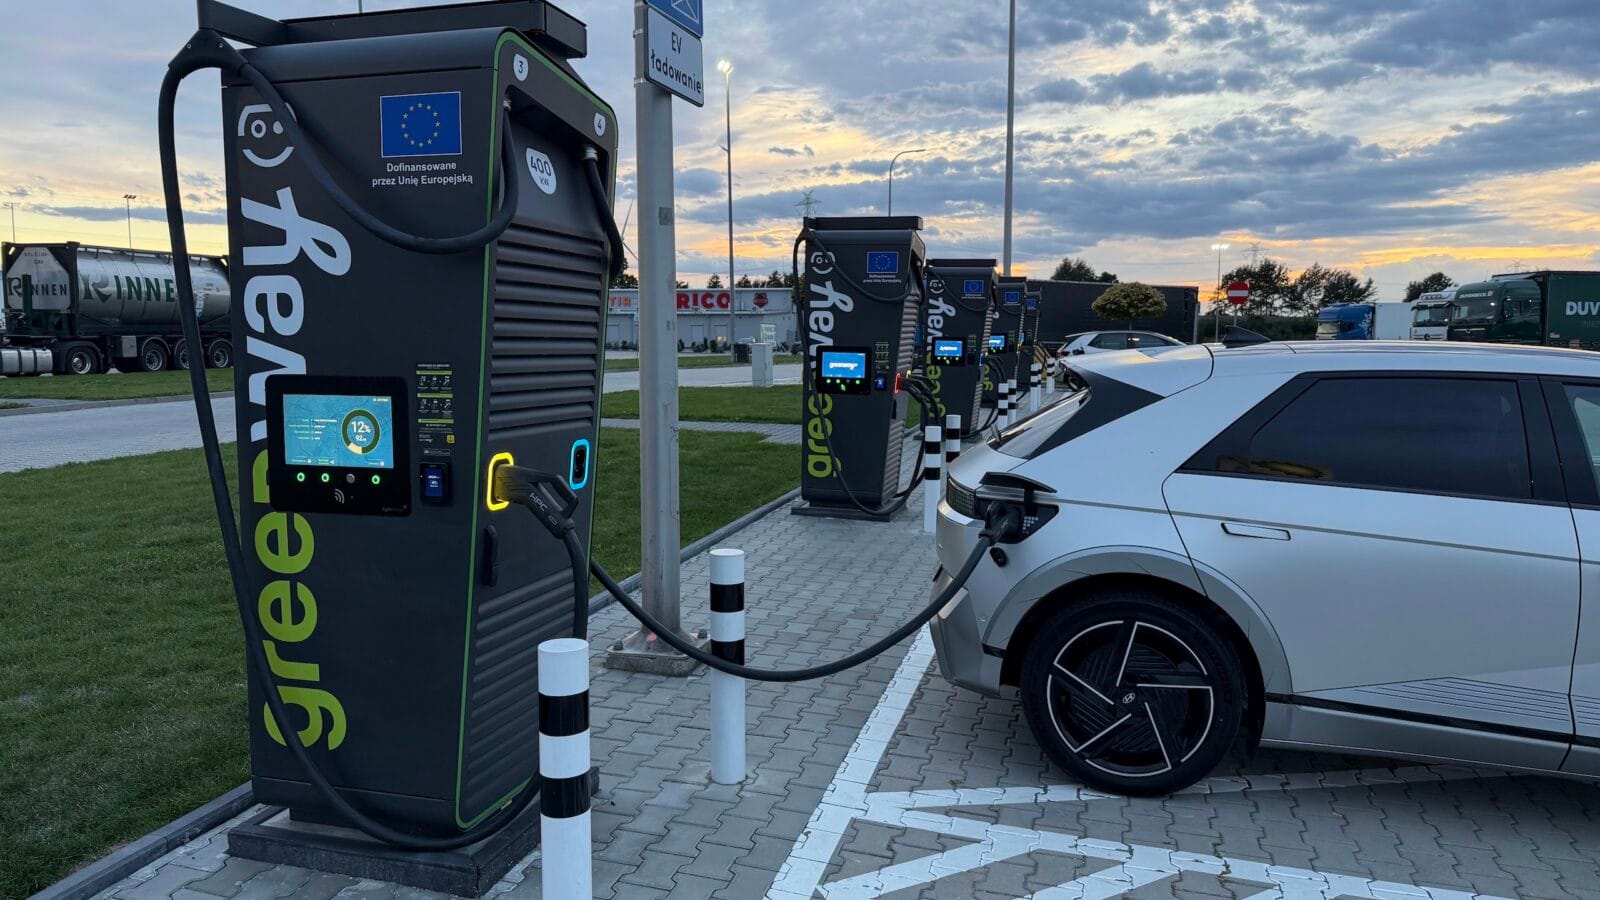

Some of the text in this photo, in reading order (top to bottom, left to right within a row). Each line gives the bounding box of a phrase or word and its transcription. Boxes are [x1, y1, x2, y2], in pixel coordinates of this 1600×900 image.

[671, 31, 683, 55] EV
[518, 60, 524, 74] 3
[650, 48, 703, 94] ładowanie
[386, 162, 457, 172] Dofinansowane
[530, 155, 552, 177] 400
[372, 173, 474, 188] przez Unię Europejską
[8, 276, 68, 298] RNNEN
[80, 273, 176, 303] RINNE
[1565, 301, 1600, 316] DUV
[807, 280, 854, 478] greeway
[351, 421, 371, 434] 12%
[240, 186, 352, 751] greeway
[529, 492, 548, 512] HPC
